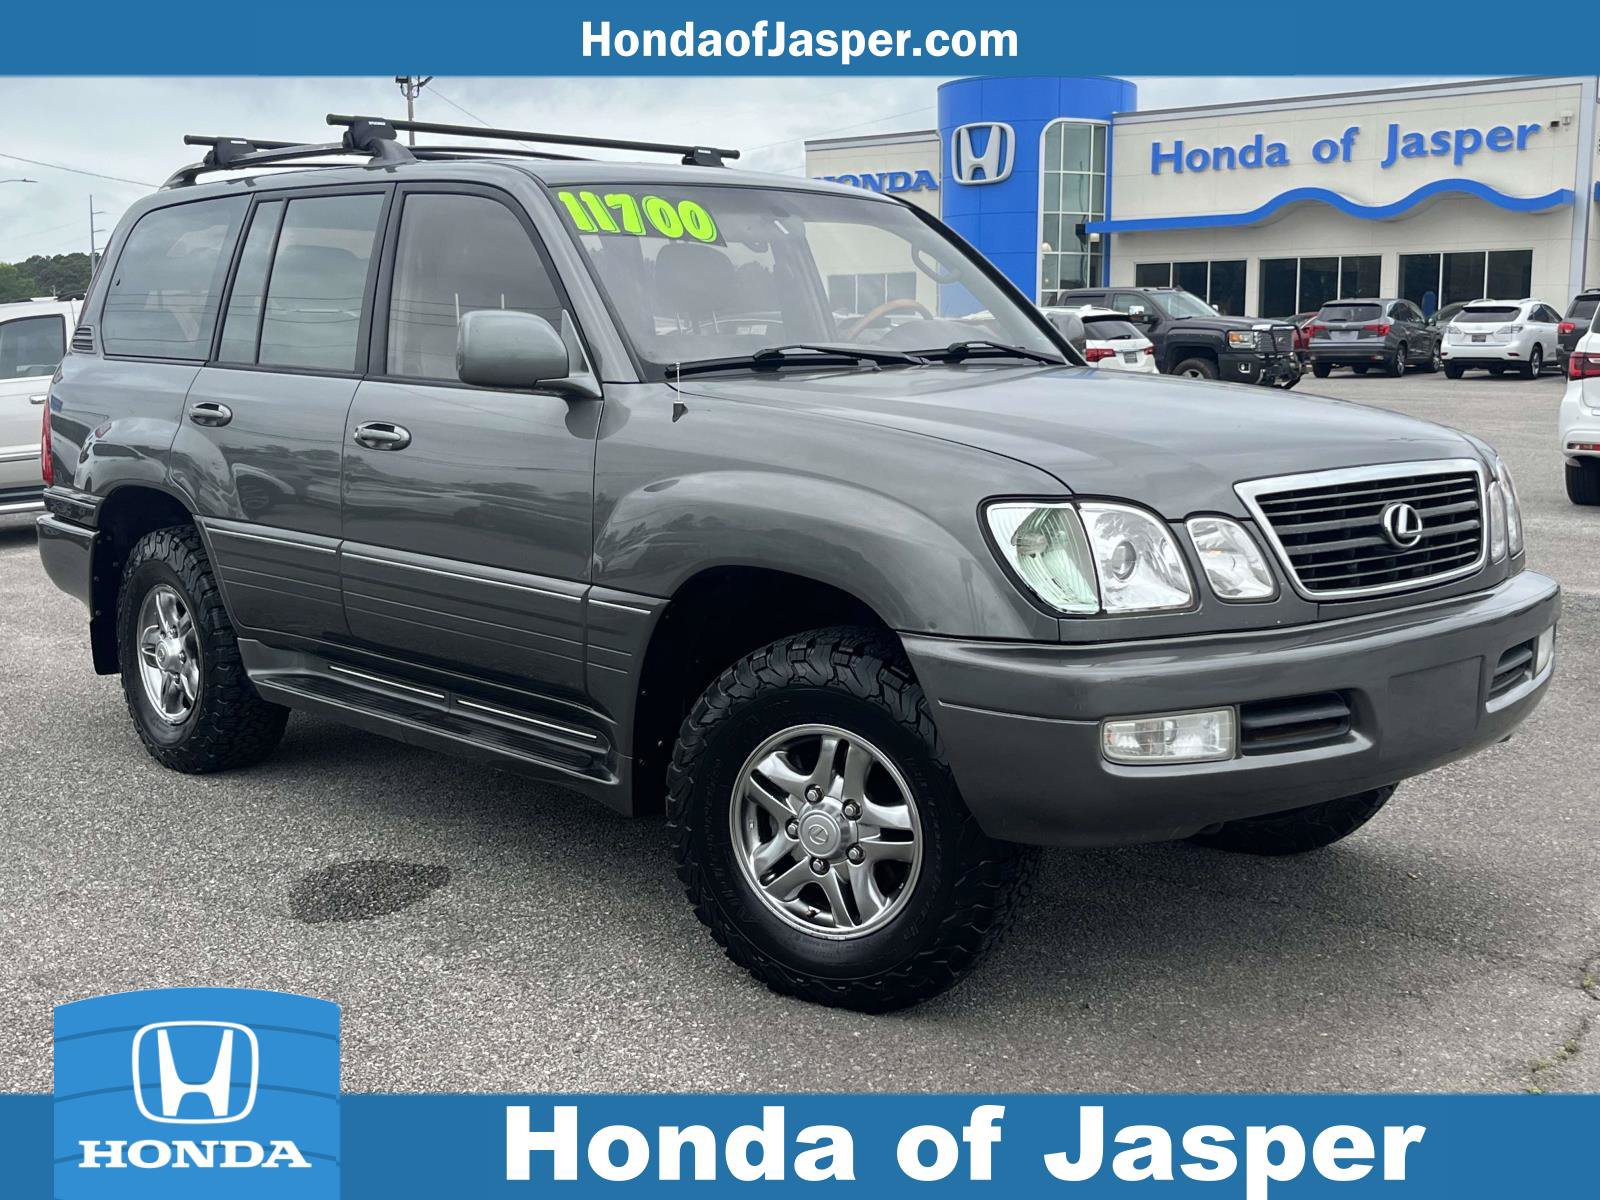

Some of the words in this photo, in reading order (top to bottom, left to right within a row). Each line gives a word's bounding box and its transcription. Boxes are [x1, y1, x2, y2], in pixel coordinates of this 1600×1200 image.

[1151, 133, 1290, 174] Honda
[1311, 126, 1360, 164] of
[1380, 122, 1541, 169] Jasper
[558, 191, 717, 242] 11700
